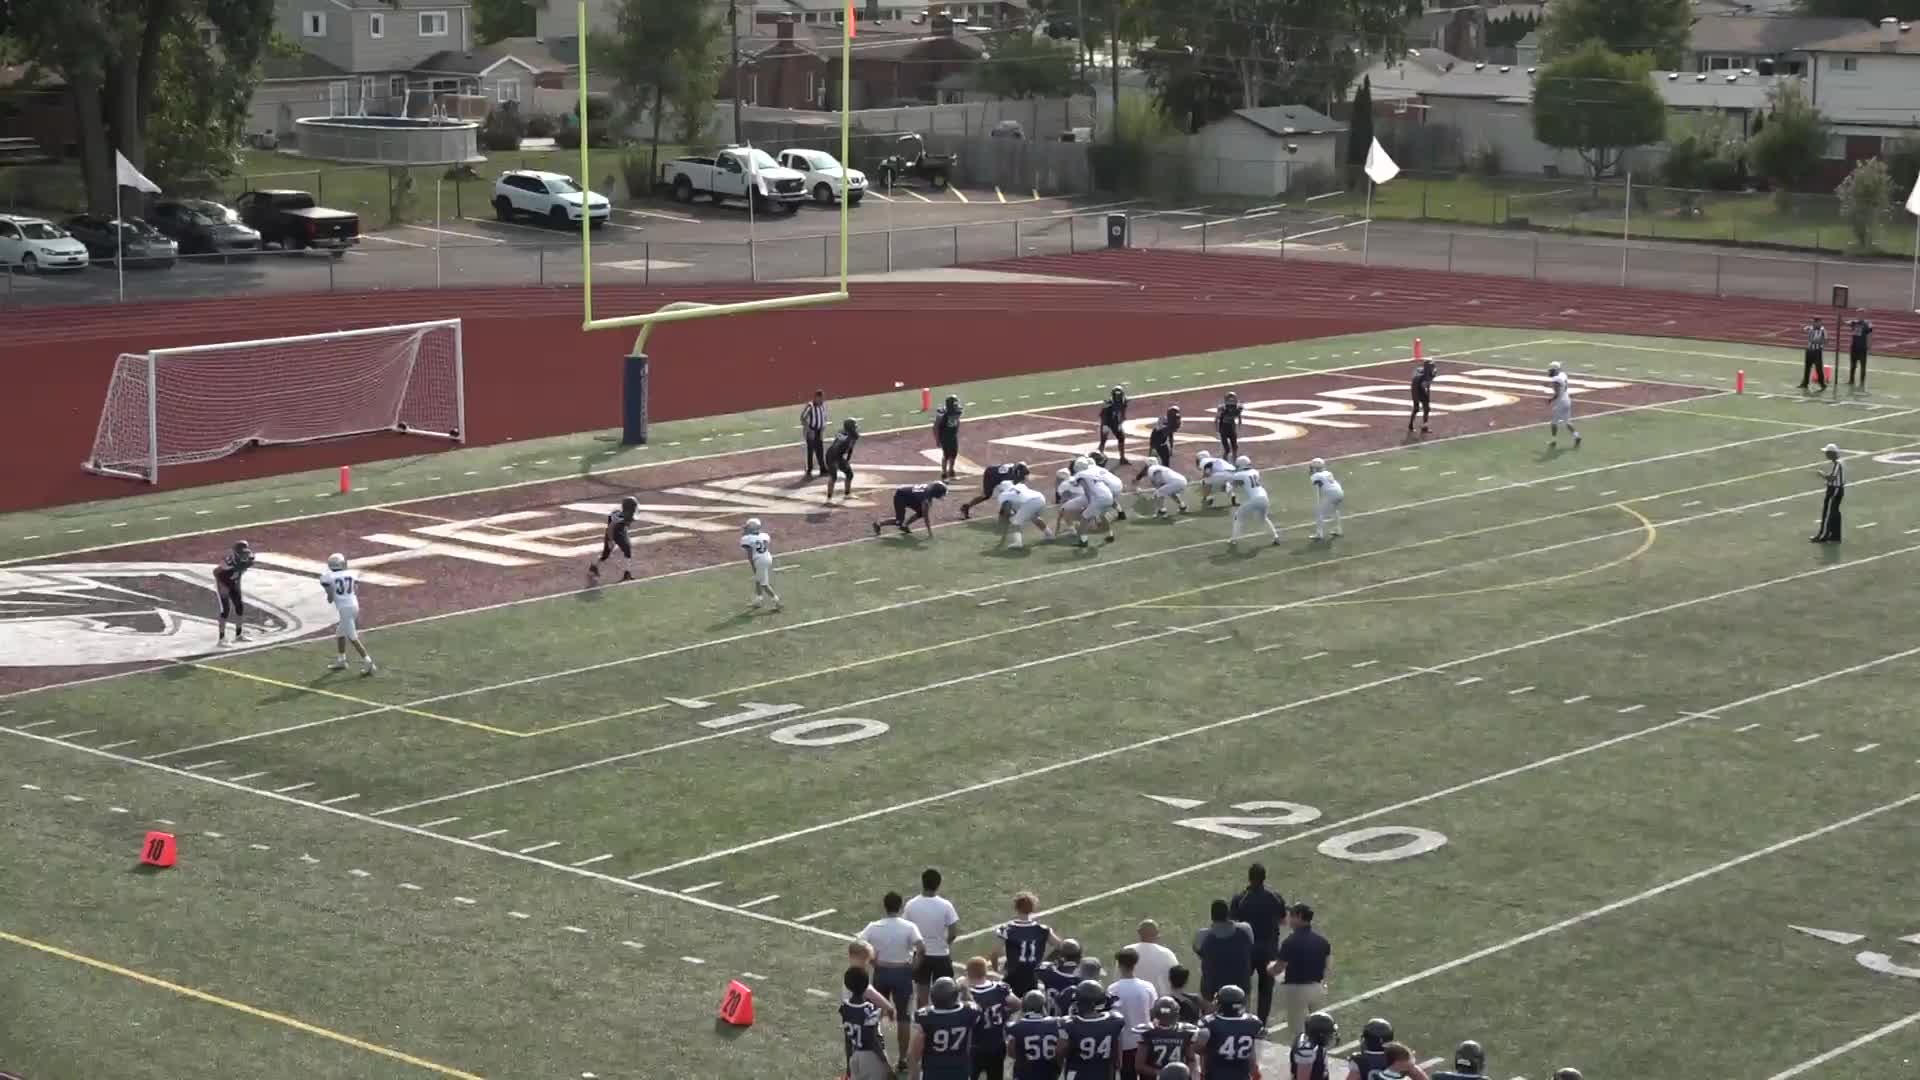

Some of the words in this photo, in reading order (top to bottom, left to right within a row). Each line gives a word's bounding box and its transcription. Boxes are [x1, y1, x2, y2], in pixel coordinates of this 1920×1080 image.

[335, 577, 352, 595] 37
[1171, 800, 1449, 862] 20
[147, 838, 165, 861] 10
[1019, 940, 1036, 962] 11
[723, 990, 741, 1017] 20
[933, 1027, 966, 1052] 97
[1024, 1034, 1057, 1060] 56
[1080, 1035, 1112, 1060] 94
[1219, 1035, 1252, 1060] 42
[1153, 1045, 1181, 1066] 74
